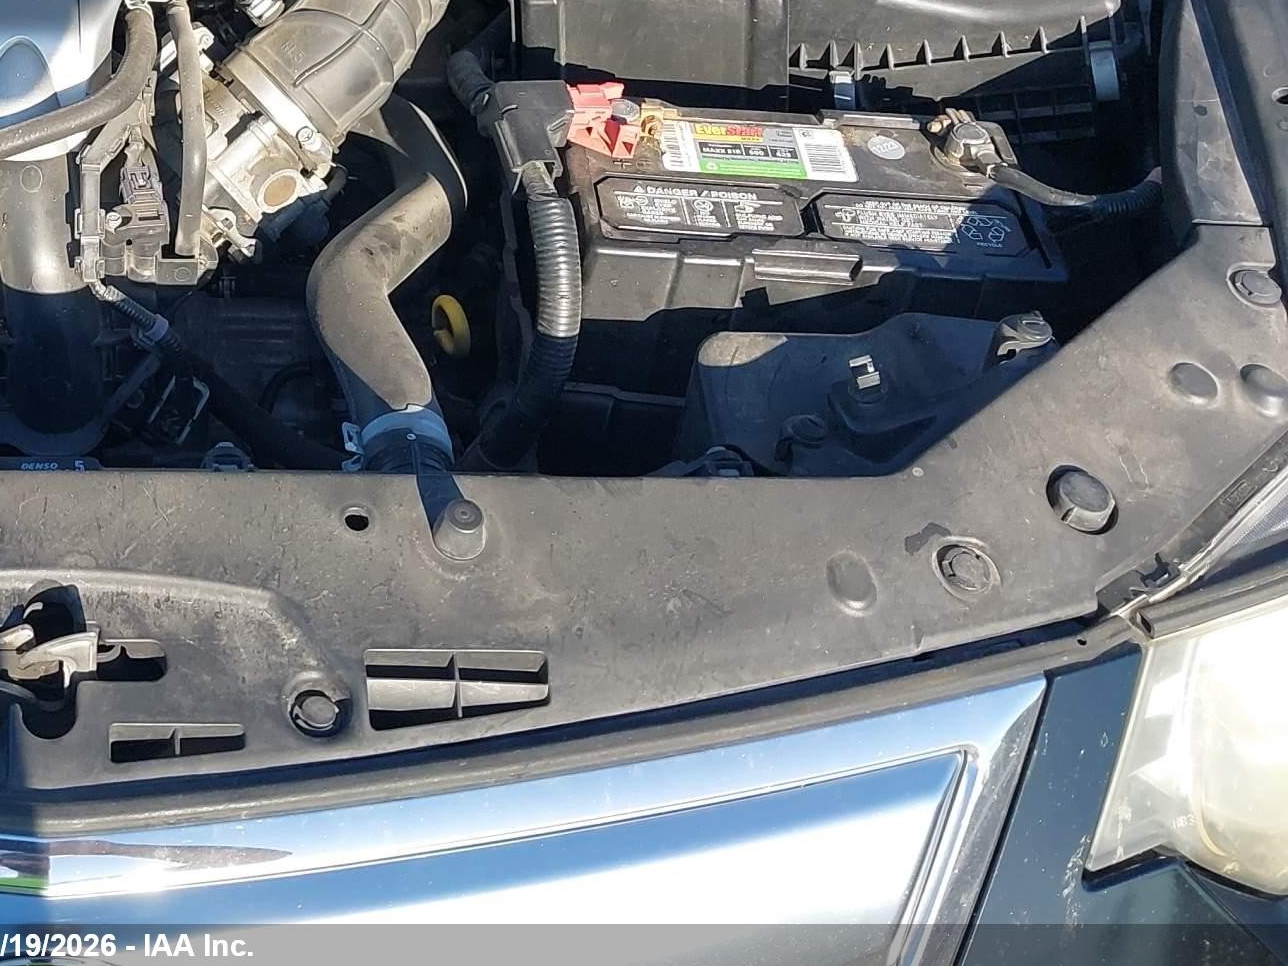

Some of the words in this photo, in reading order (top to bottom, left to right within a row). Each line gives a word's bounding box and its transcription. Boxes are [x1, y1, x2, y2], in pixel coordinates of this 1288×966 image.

[695, 123, 764, 138] EverStart
[647, 186, 699, 197] DANGER
[711, 191, 757, 200] POISON
[20, 462, 59, 471] DENSO
